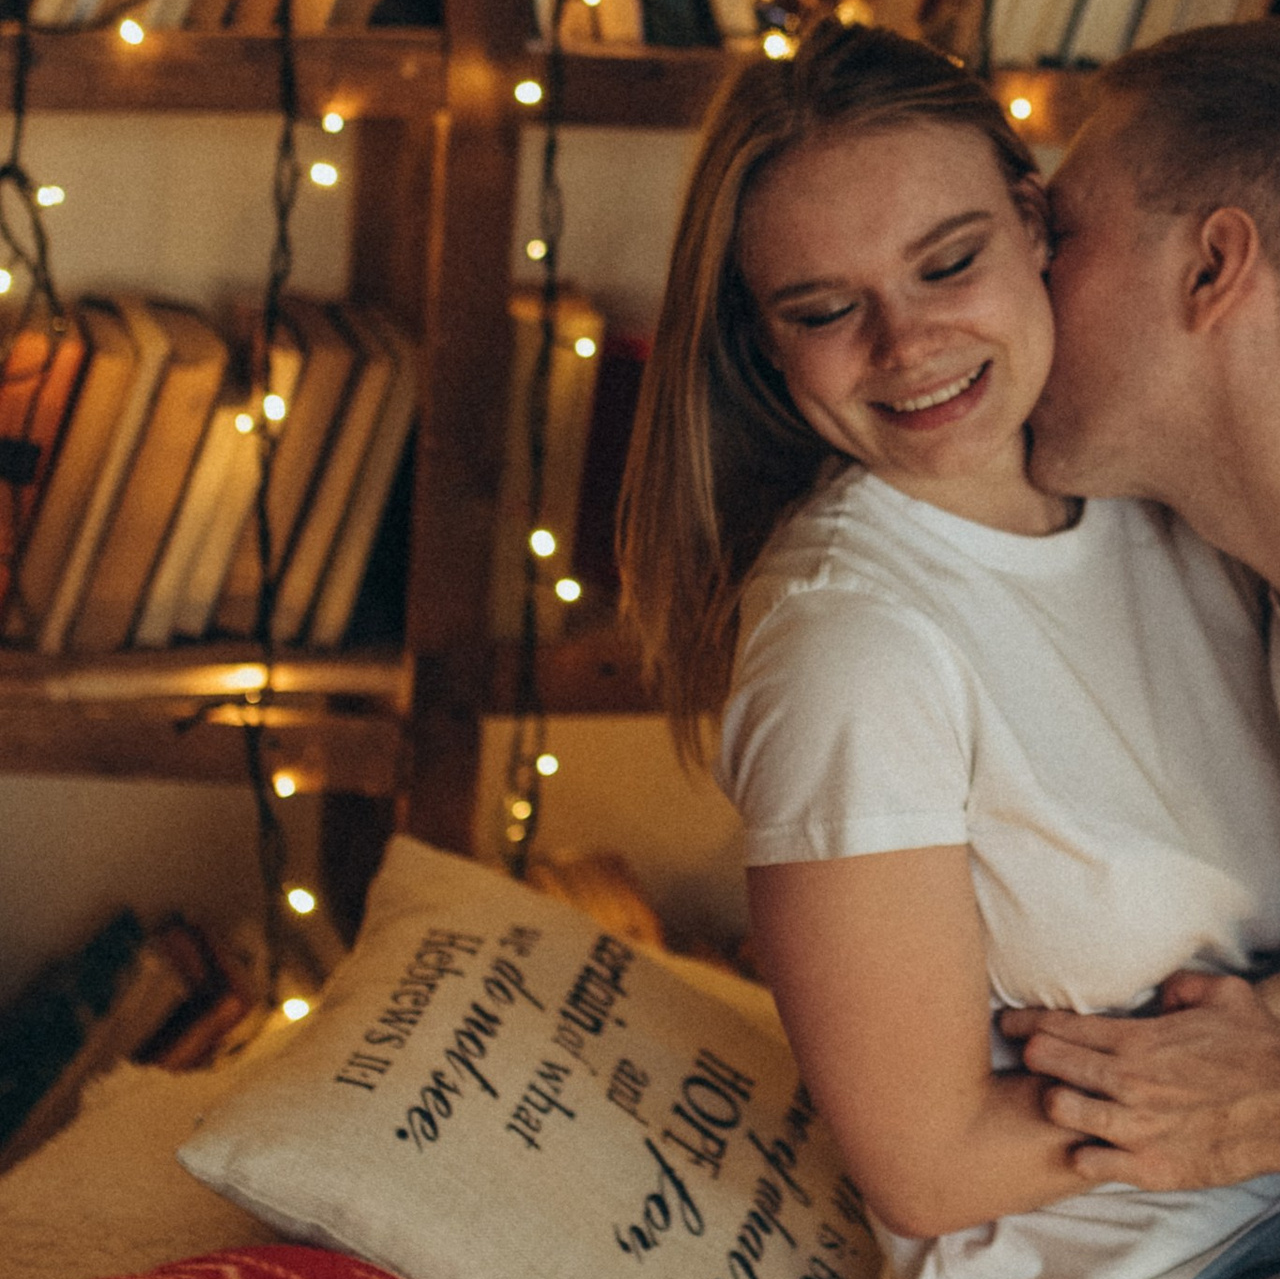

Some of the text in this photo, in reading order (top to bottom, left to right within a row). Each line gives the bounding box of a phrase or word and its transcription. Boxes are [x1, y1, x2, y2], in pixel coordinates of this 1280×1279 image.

[334, 928, 484, 1092] Hebrews 11:1
[394, 925, 547, 1155] we do not see.
[505, 932, 636, 1152] certain of what
[605, 1056, 650, 1129] and
[612, 1047, 757, 1266] HOPE for,
[747, 1128, 812, 1210] of
[817, 1221, 859, 1262] is
